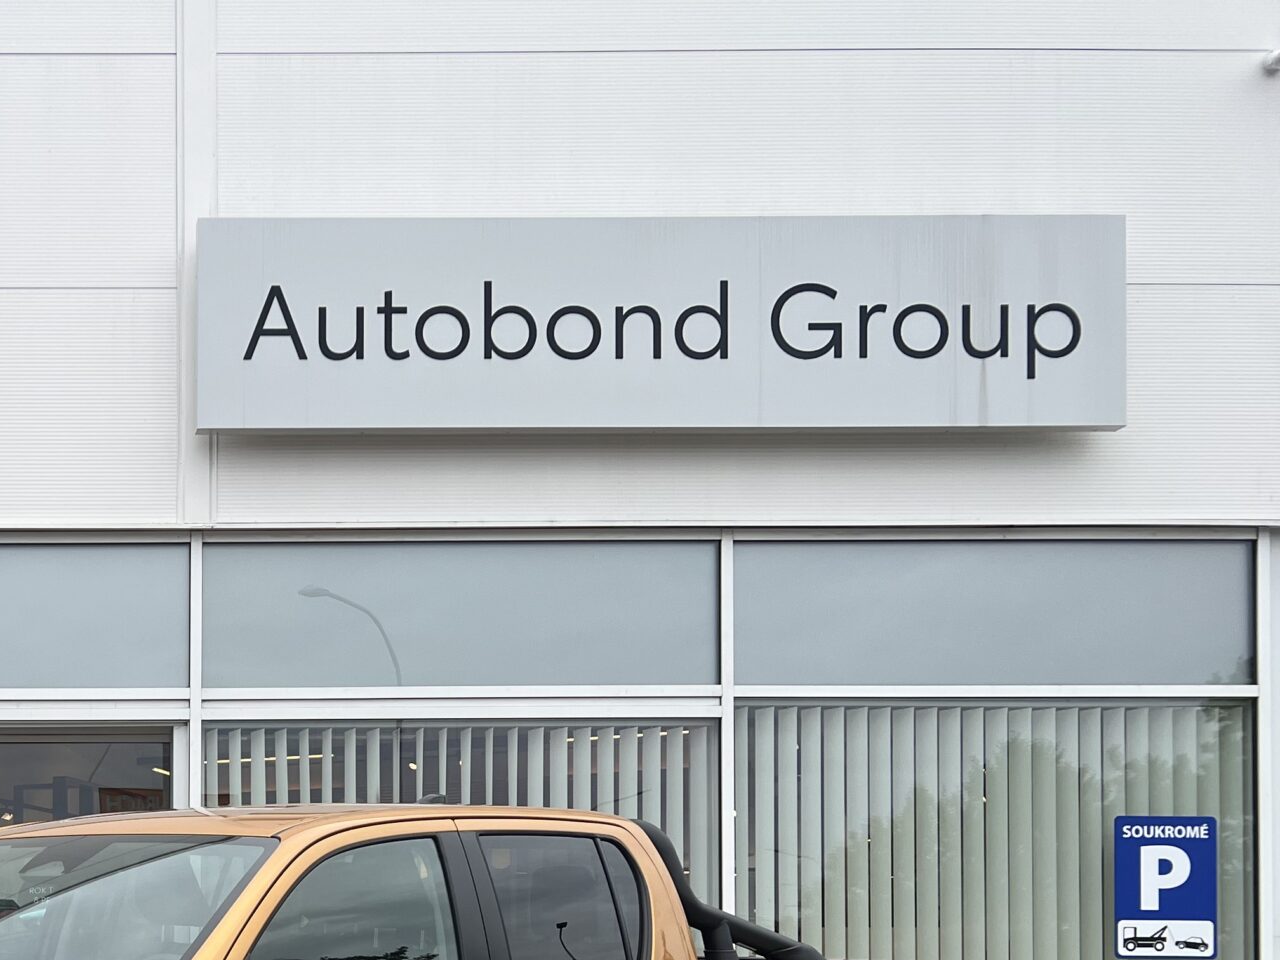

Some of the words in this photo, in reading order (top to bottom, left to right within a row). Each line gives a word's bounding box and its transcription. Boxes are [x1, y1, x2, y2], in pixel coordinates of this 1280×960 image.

[242, 279, 730, 362] Autobond
[770, 282, 1084, 380] Group
[1122, 823, 1209, 838] SOUKROMÉ
[1139, 844, 1192, 911] P
